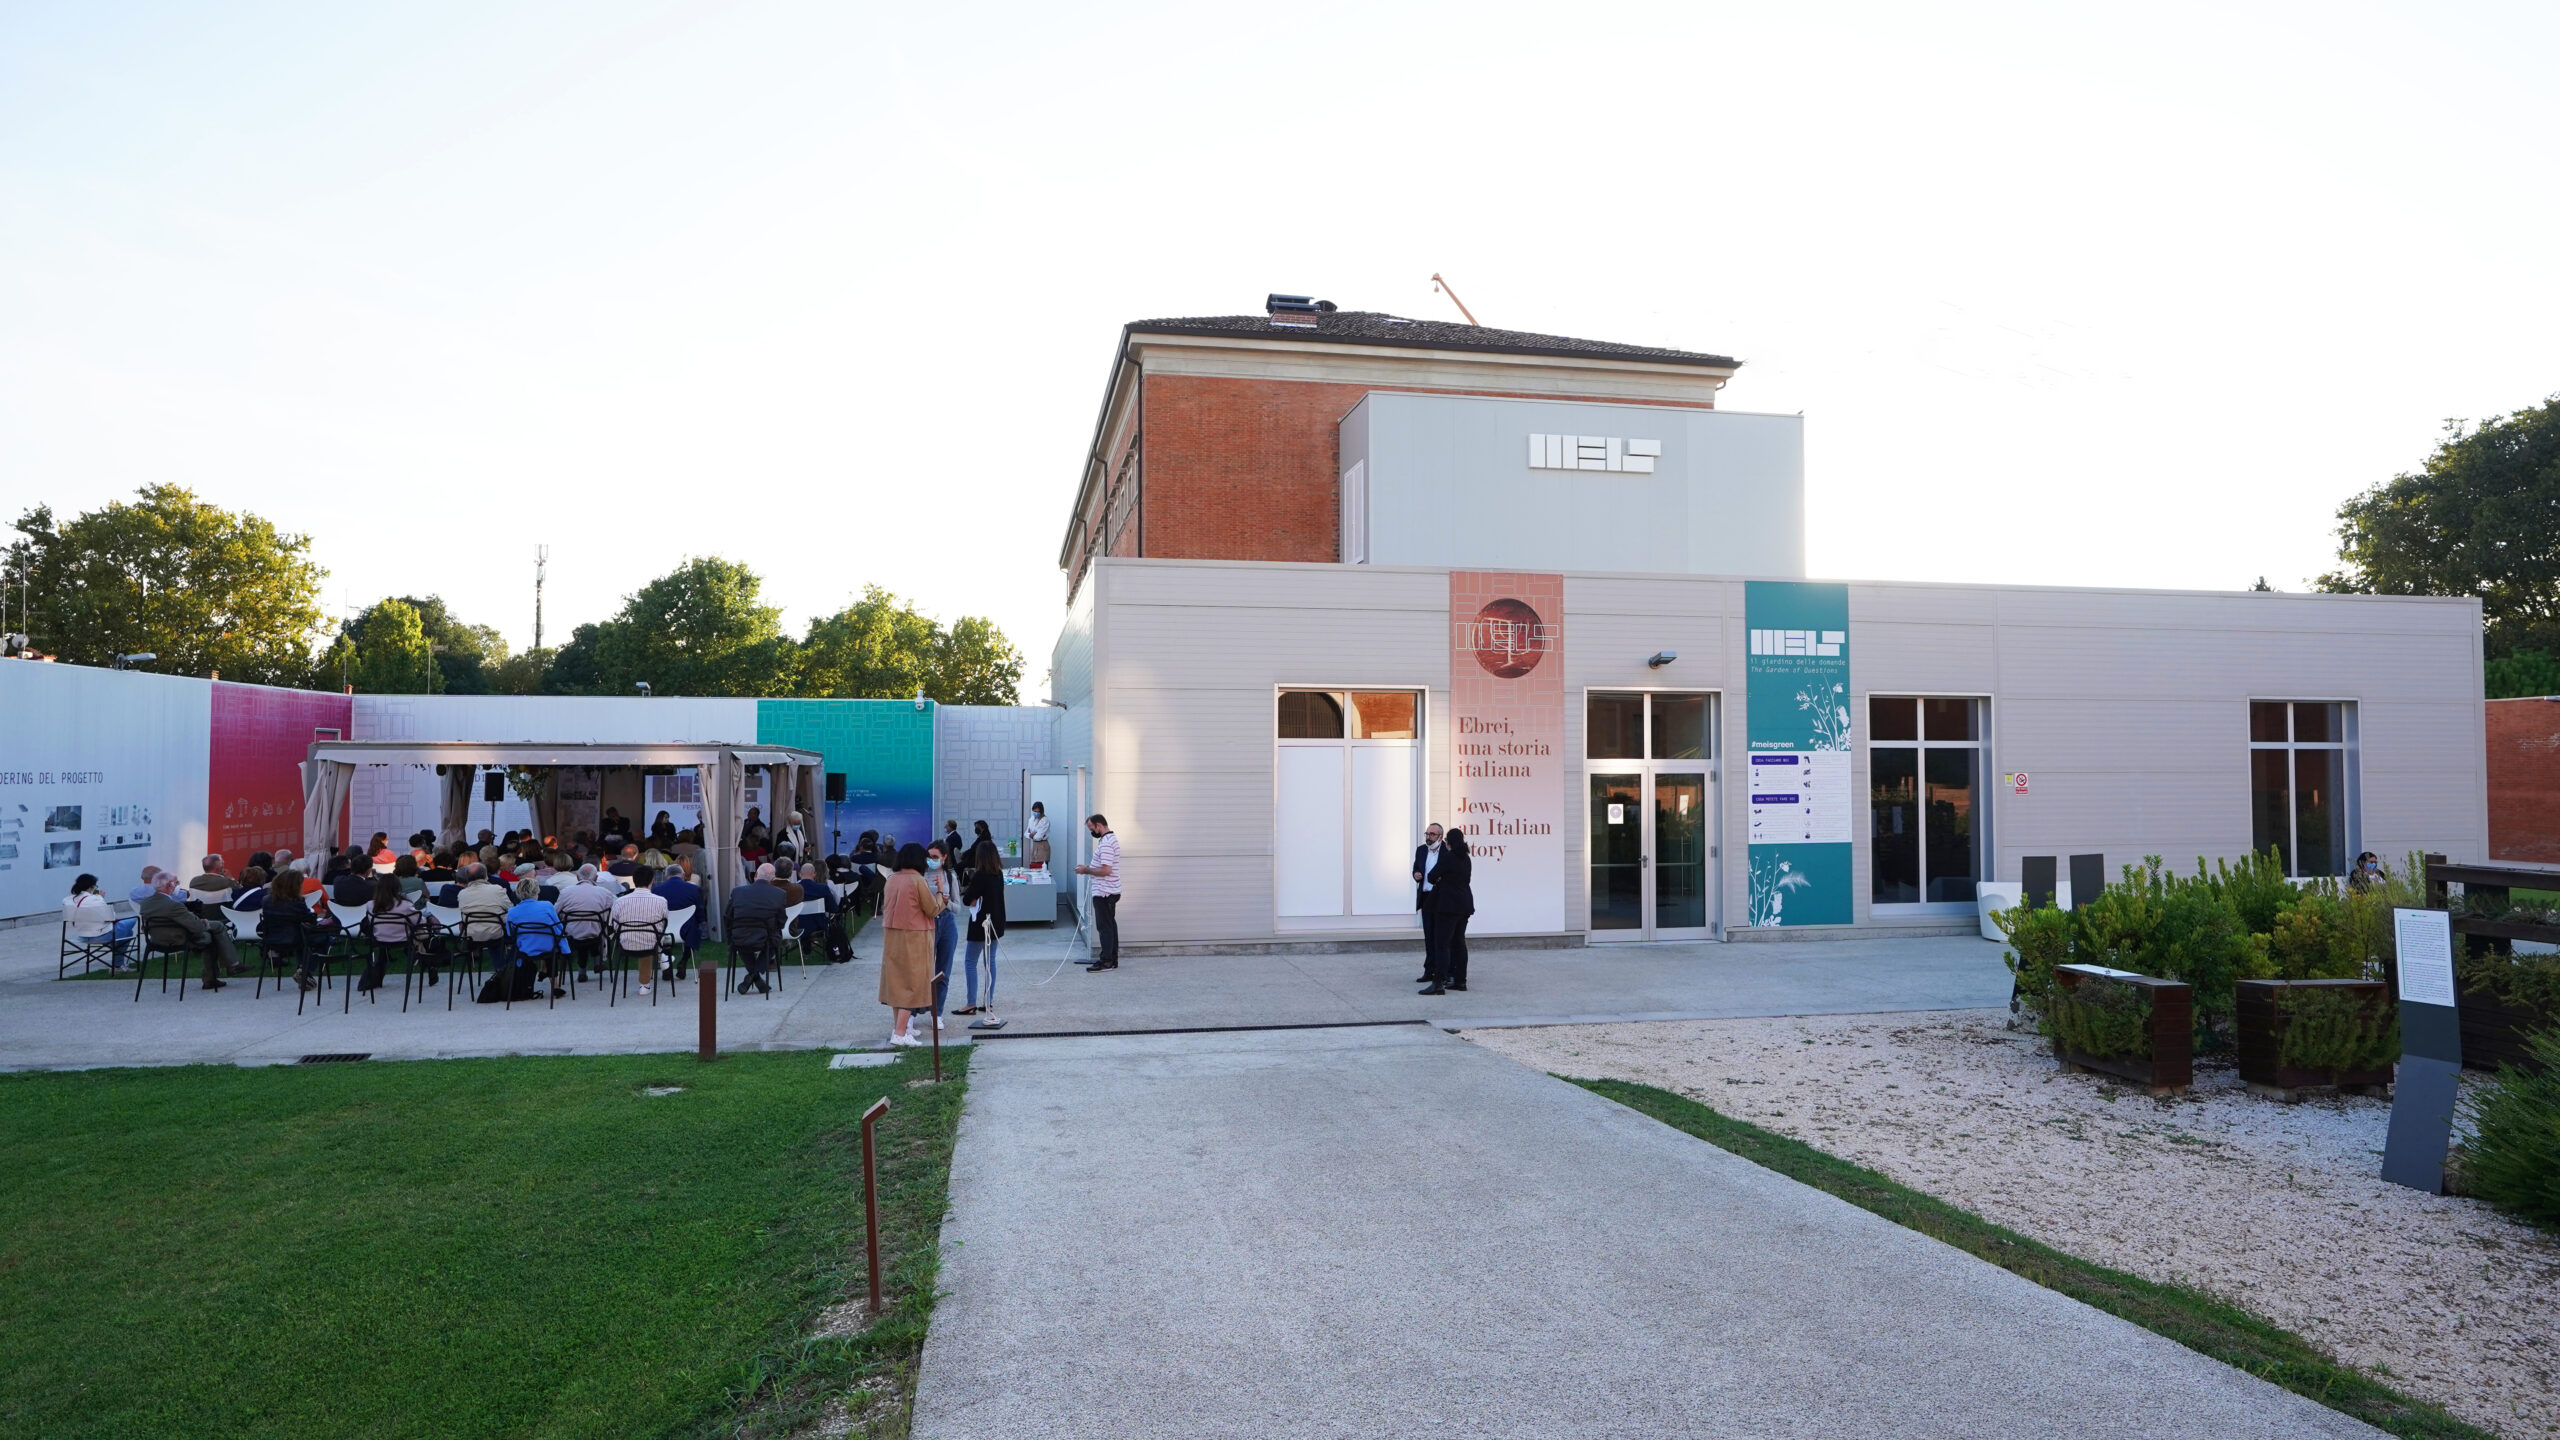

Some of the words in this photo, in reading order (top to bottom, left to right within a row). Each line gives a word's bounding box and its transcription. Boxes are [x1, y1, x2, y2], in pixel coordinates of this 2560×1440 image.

[1761, 658, 1793, 667] giardino
[1796, 658, 1816, 666] delle
[1458, 716, 1514, 737] Ebrei,
[1458, 743, 1493, 756] una
[1498, 739, 1552, 756] storia
[1751, 741, 1795, 750] #meisgreen
[1458, 760, 1532, 777] italiana
[39, 772, 56, 784] DEL
[61, 771, 104, 784] PROGETTO
[1457, 797, 1505, 817] Jews,
[1458, 824, 1480, 835] an
[1487, 818, 1552, 836] Italian
[1471, 842, 1507, 862] tory
